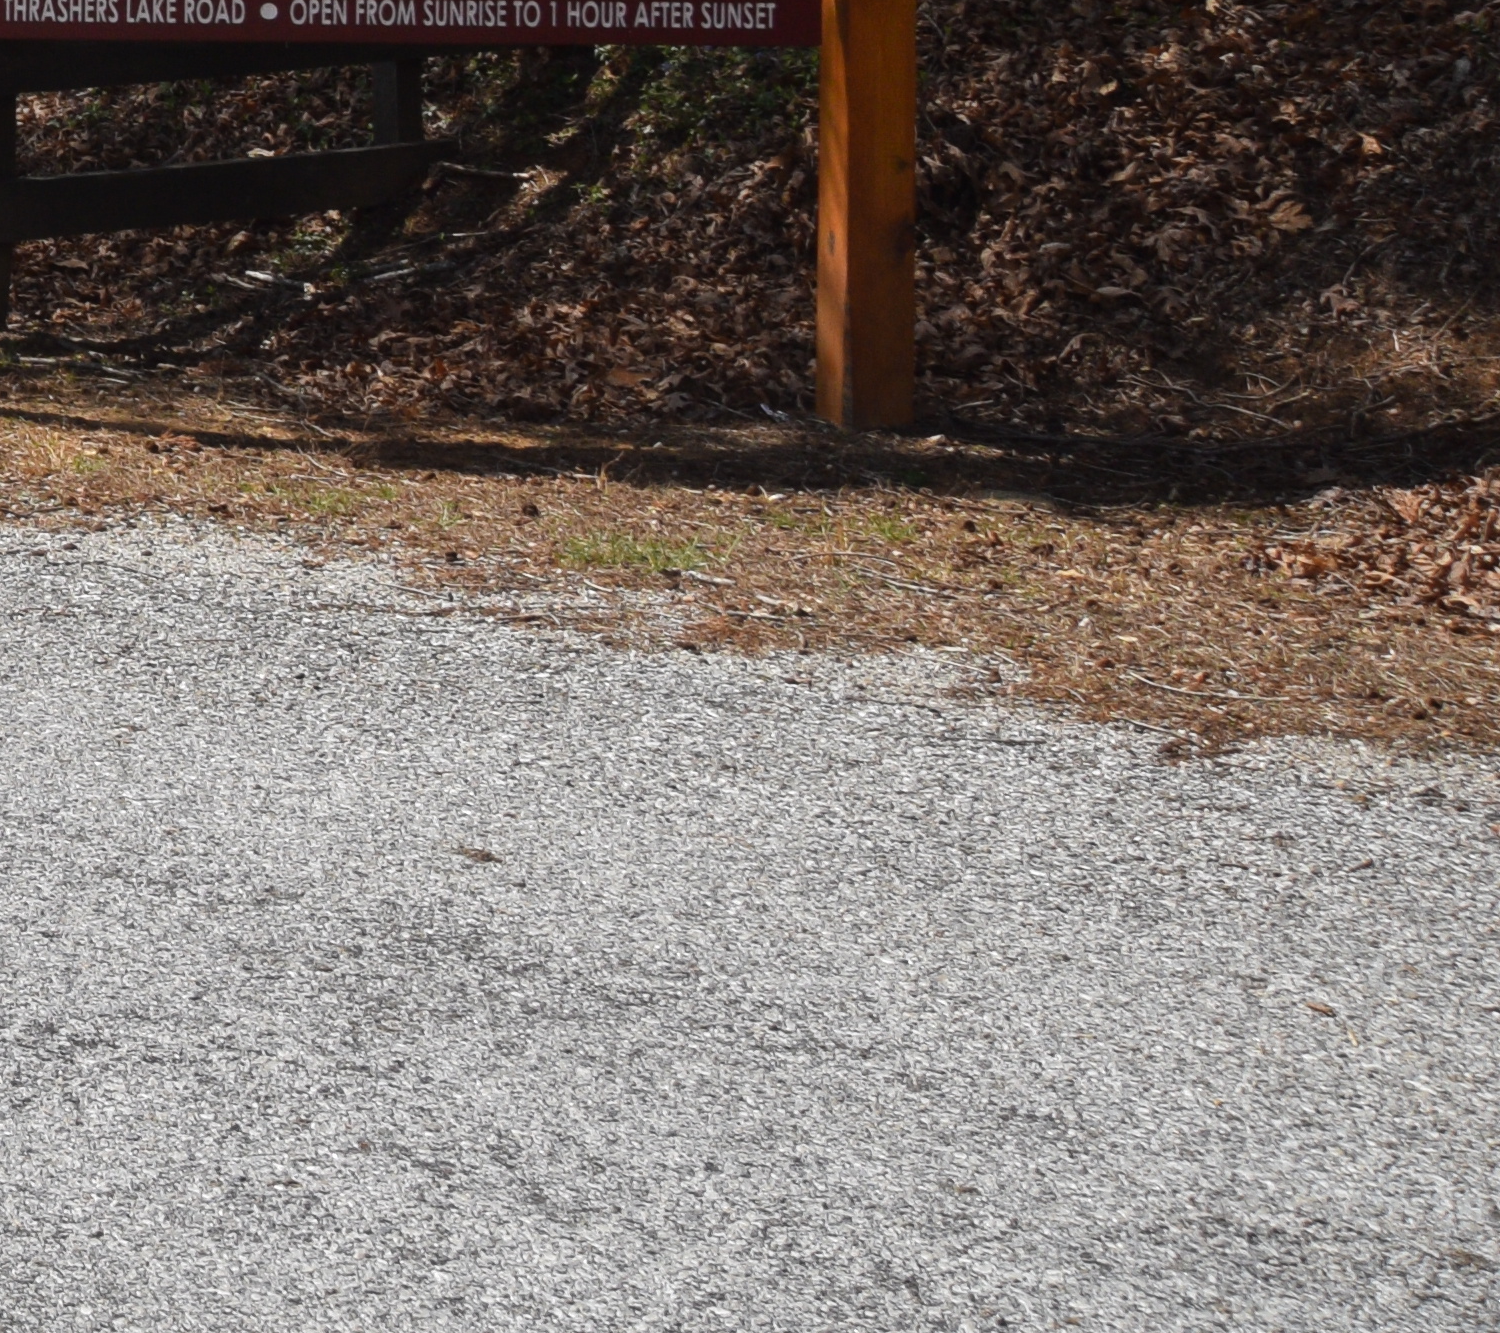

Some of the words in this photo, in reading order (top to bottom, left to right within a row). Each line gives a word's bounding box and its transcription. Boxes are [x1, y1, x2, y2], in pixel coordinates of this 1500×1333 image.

[355, 0, 416, 26] FROM
[422, 0, 507, 27] SUNRISE
[513, 0, 541, 28] TO
[550, 2, 558, 28] 1
[567, 1, 627, 29] HOUR
[634, 2, 694, 29] AFTER
[700, 3, 776, 30] SUNSET
